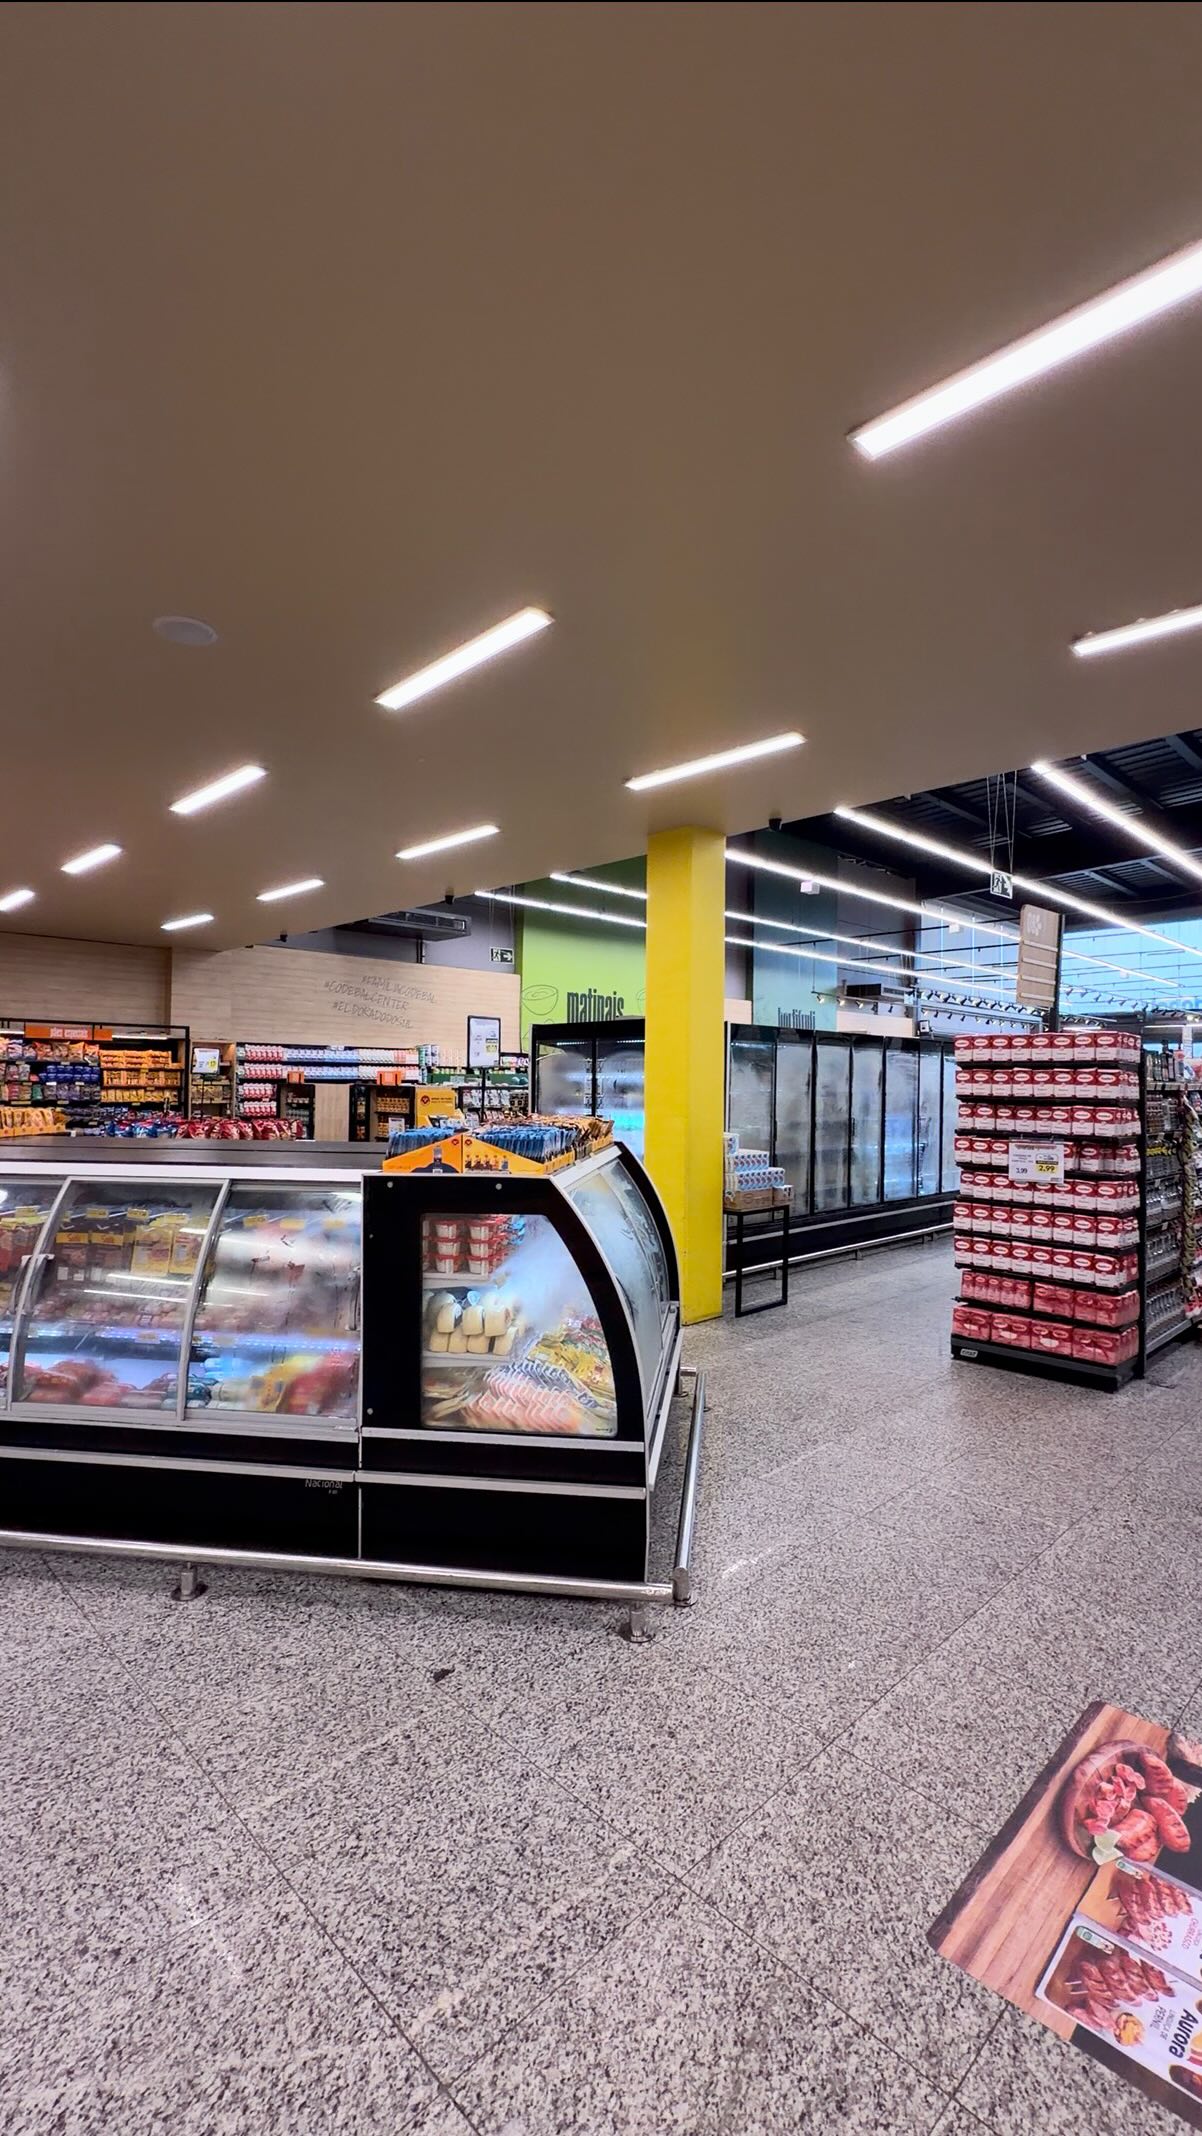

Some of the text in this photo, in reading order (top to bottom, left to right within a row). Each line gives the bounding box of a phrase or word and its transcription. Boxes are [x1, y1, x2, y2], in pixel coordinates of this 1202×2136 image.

[567, 988, 624, 1023] matinais
[305, 1479, 343, 1488] Nacional
[1168, 2008, 1199, 2058] Aurora
